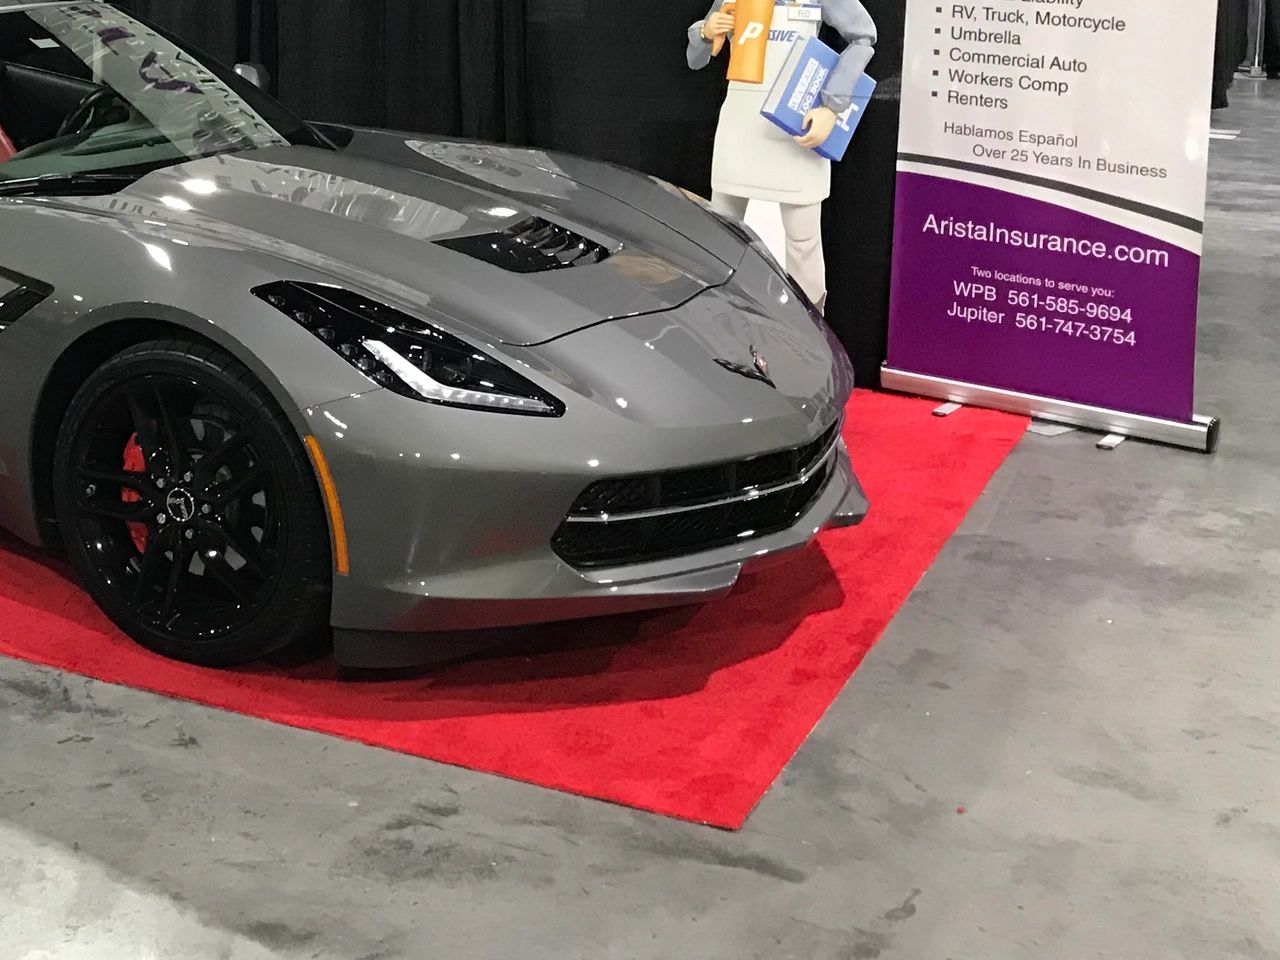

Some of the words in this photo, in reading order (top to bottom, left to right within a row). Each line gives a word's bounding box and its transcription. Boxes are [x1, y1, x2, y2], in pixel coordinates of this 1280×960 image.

[952, 4, 977, 21] RV,
[982, 7, 1028, 26] Truck,
[1035, 11, 1126, 33] Motorcycle
[951, 26, 1021, 45] Umbrella
[949, 47, 1045, 69] Commercial
[1049, 56, 1087, 73] Auto
[948, 68, 1013, 88] Workers
[1018, 75, 1068, 96] Comp
[948, 90, 1008, 109] Renters
[944, 121, 1013, 141] Hablamos
[1019, 130, 1078, 148] Español
[972, 144, 1007, 159] Over
[1010, 149, 1028, 162] 25
[1032, 150, 1073, 167] Years
[1078, 156, 1091, 169] In
[1096, 158, 1167, 178] Business
[922, 213, 1170, 268] AristaInsurance.com
[971, 266, 992, 278] Two
[994, 270, 1042, 286] locations
[1044, 278, 1055, 288] to
[1058, 282, 1088, 293] serve
[1091, 287, 1114, 298] you:
[953, 280, 996, 301] WPB
[1008, 287, 1132, 326] 561-585-9694
[947, 302, 1005, 324] Jupiter
[1015, 310, 1136, 346] 561-747-3754
